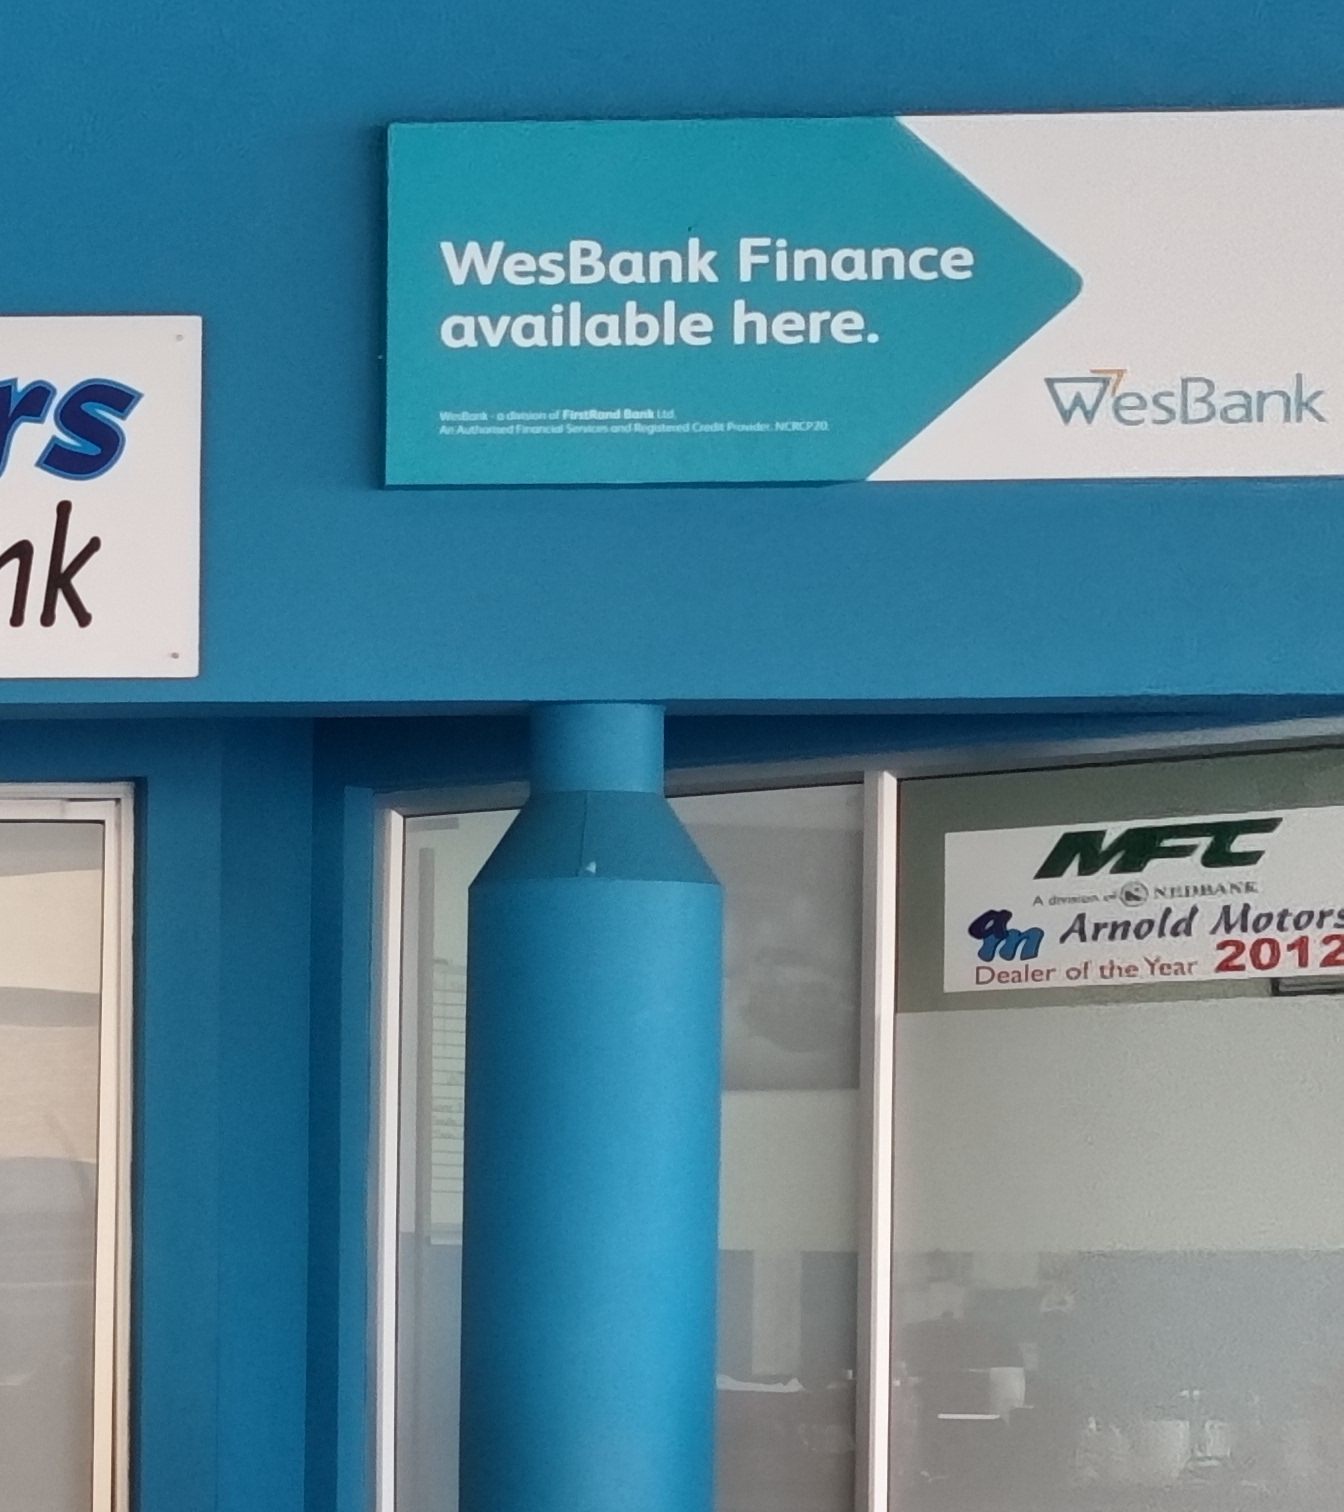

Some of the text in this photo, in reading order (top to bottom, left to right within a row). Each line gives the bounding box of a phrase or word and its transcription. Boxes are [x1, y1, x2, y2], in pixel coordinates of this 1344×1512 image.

[439, 236, 975, 287] WesBank Finance
[440, 299, 880, 349] available here.
[562, 409, 621, 420] FirstRand
[623, 409, 655, 419] Bank
[1043, 367, 1327, 428] WesBank
[1033, 817, 1284, 880] MFC
[1059, 903, 1344, 944] Arnold Motors
[975, 934, 1344, 986] Dealer of the Year 2012
